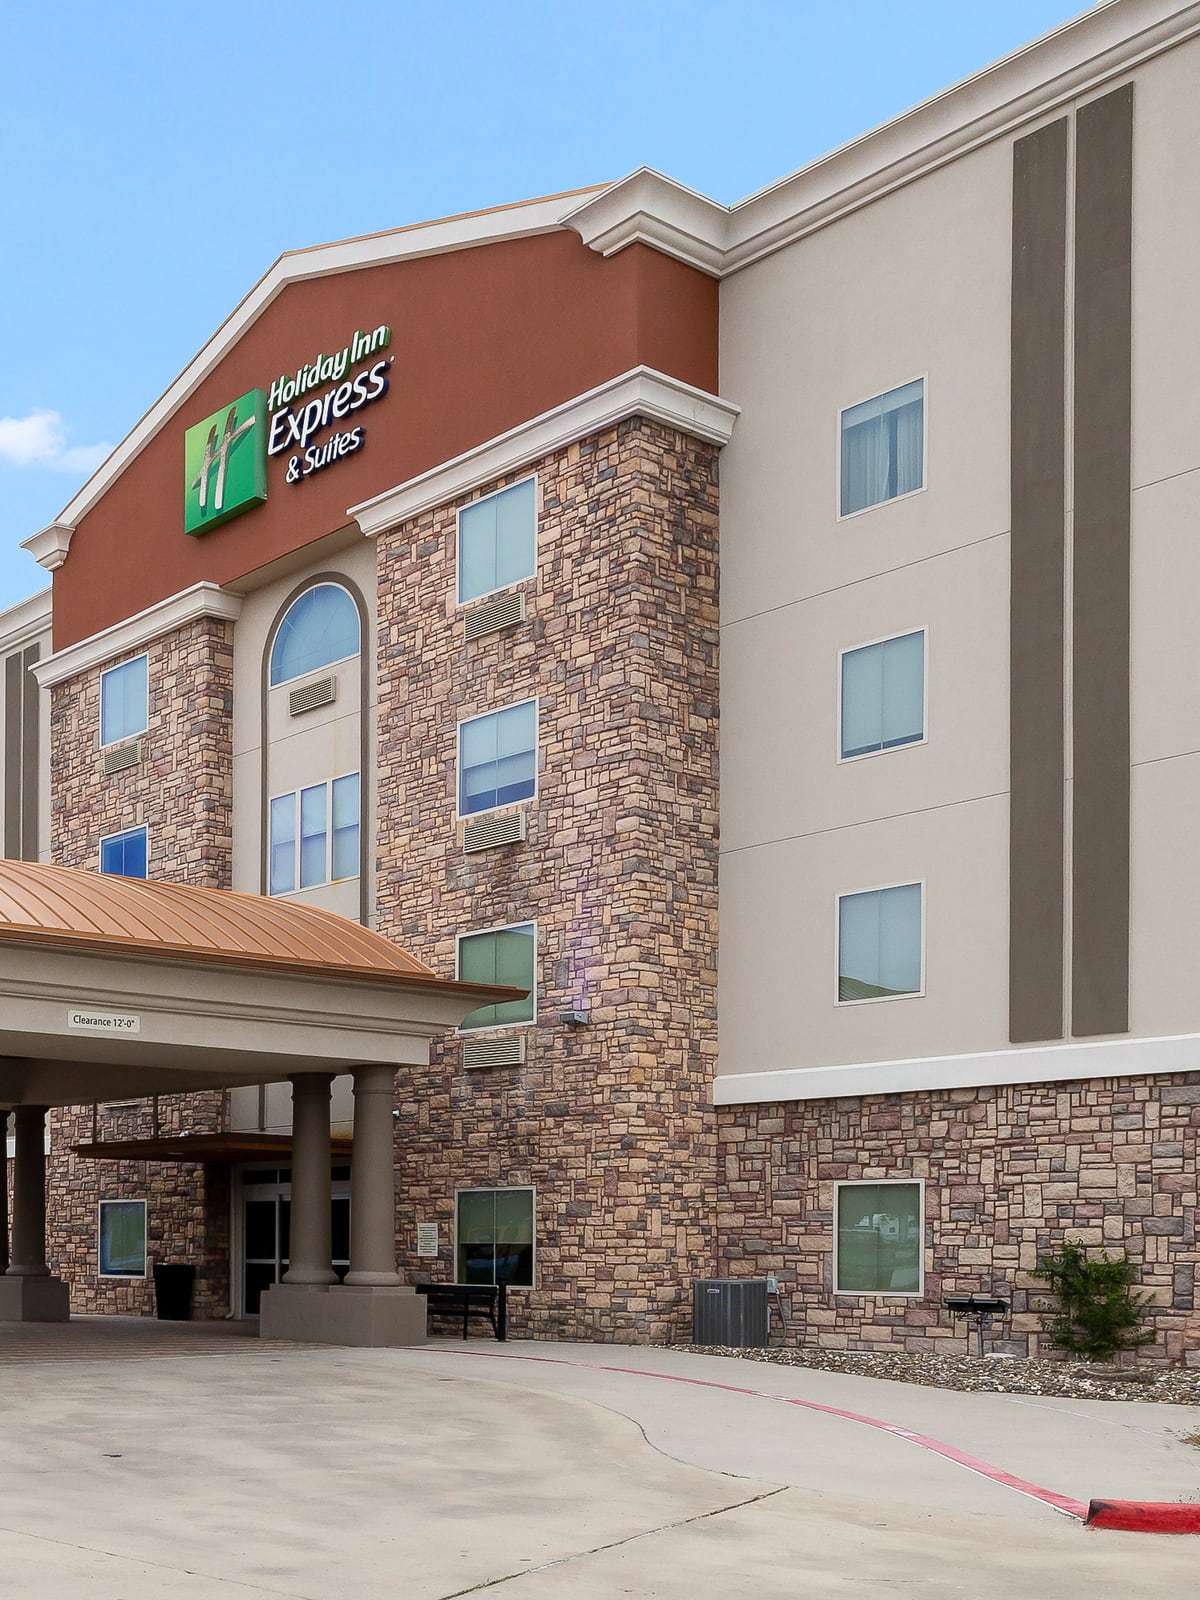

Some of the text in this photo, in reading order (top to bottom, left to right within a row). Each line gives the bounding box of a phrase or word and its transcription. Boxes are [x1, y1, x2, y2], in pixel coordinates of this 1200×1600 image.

[268, 325, 390, 411] Holiday Inn
[268, 360, 388, 456] Express
[286, 427, 362, 483] & Suites
[73, 1014, 111, 1027] Clearance
